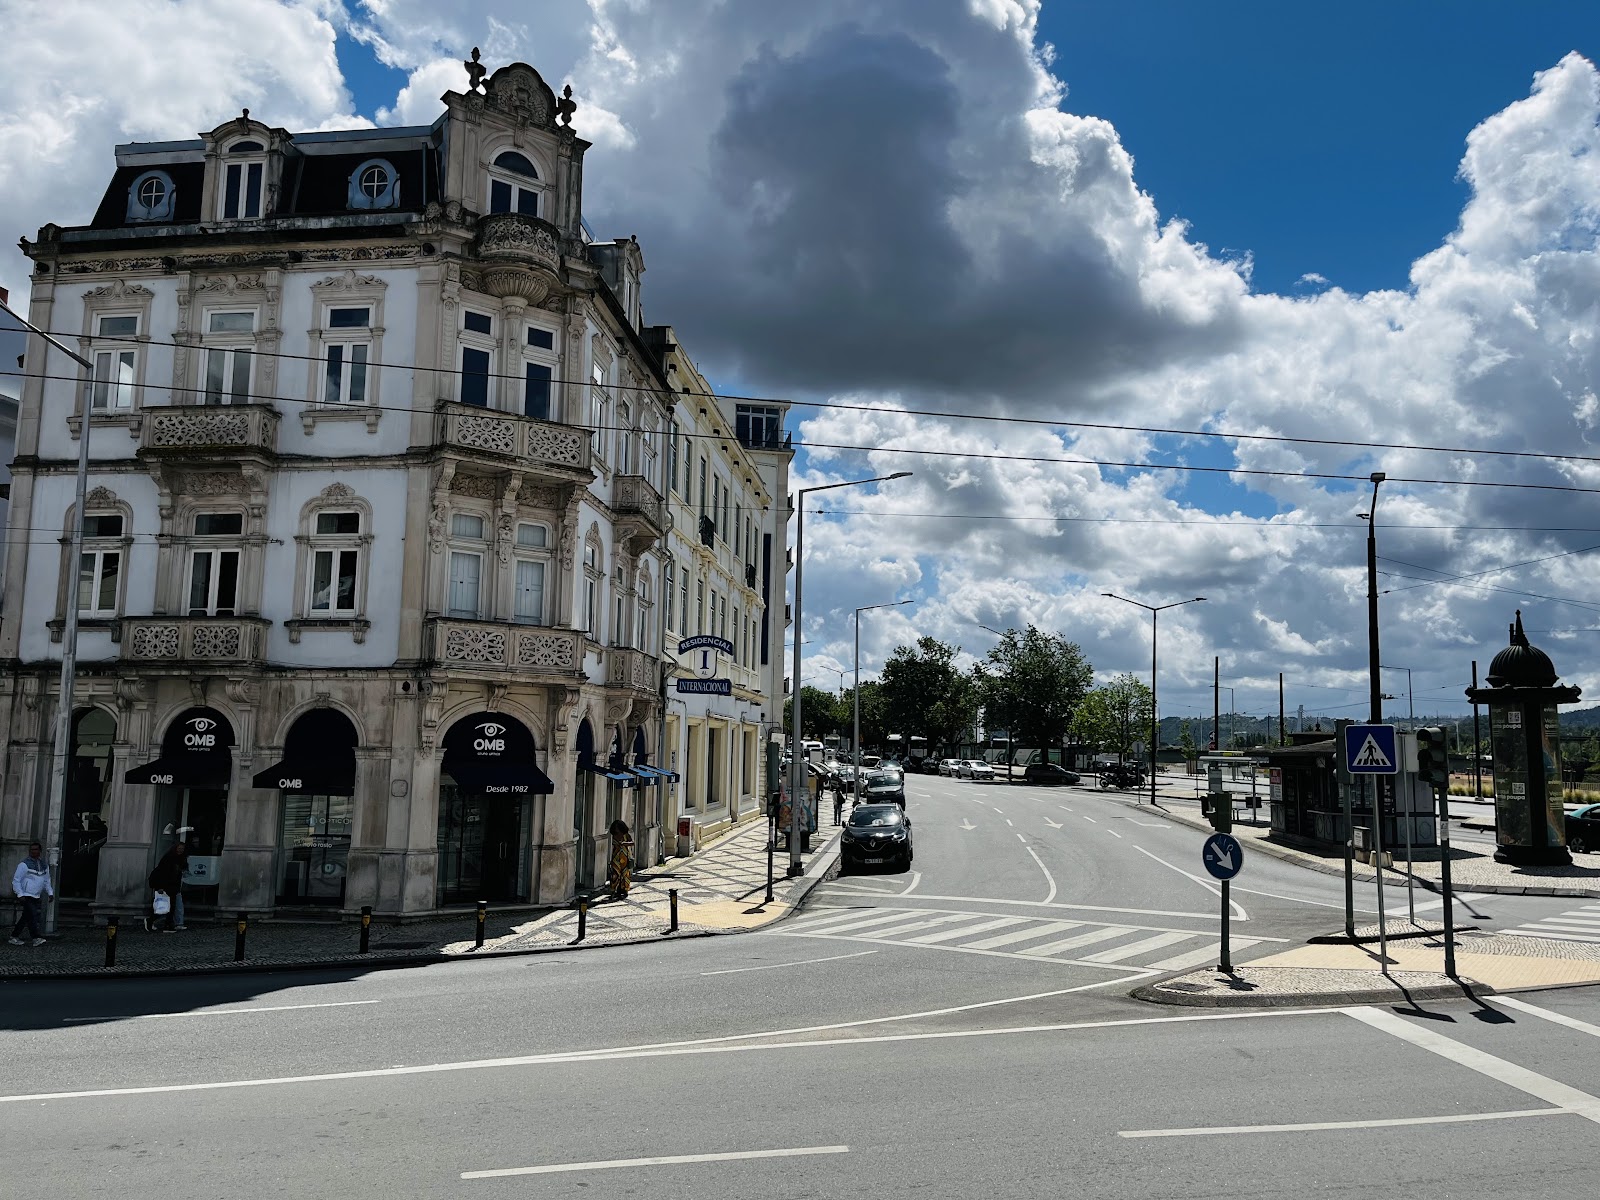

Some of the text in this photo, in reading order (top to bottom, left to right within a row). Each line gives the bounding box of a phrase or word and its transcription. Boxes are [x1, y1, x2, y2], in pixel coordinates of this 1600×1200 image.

[681, 637, 731, 651] RESIDENCIAL
[679, 681, 729, 692] INTERNACIONAL
[184, 733, 216, 747] OMB
[474, 738, 505, 751] OMB
[150, 774, 174, 784] OMB
[278, 778, 303, 789] OMB
[486, 785, 529, 793] Desde 1982
